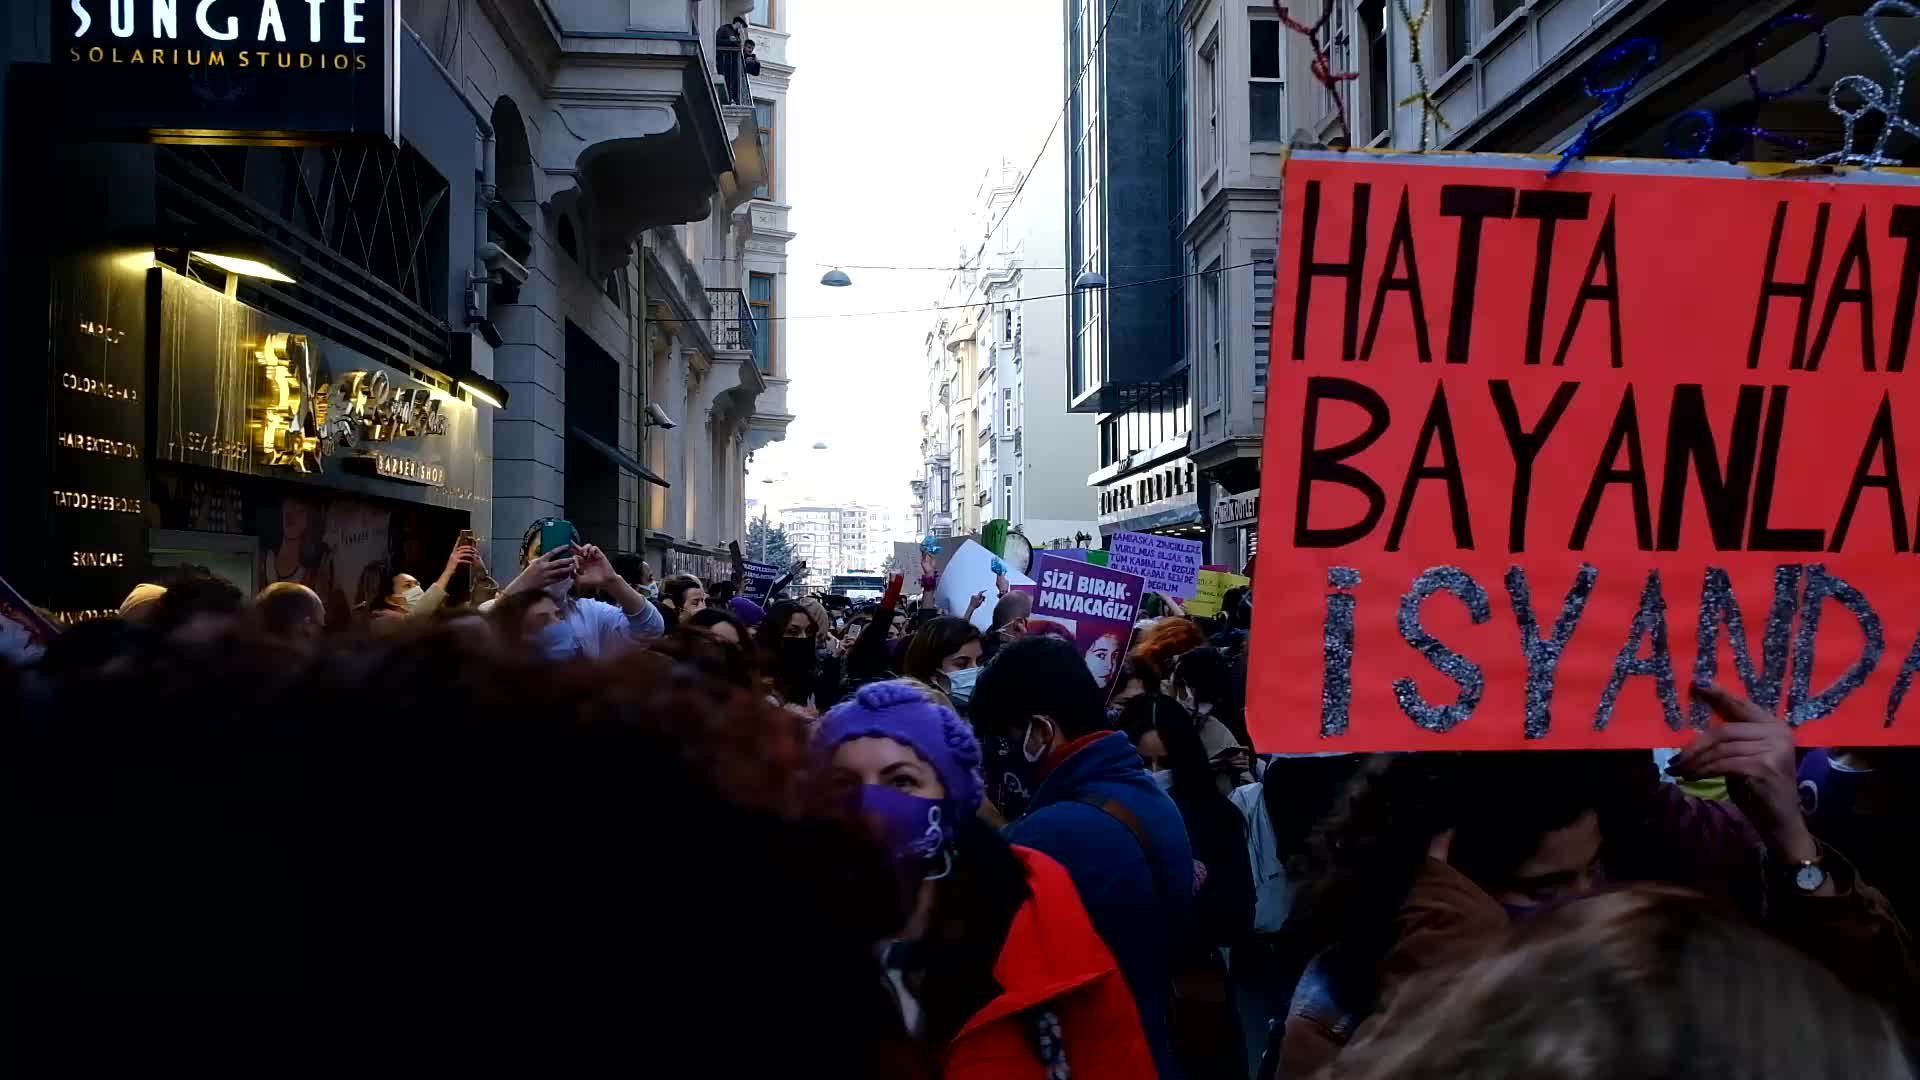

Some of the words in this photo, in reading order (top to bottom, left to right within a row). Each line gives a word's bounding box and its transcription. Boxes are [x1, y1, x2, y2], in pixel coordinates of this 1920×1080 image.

[70, 0, 366, 43] SUNGATE
[70, 46, 225, 67] SOLARIUM
[239, 50, 367, 71] STUDIOS
[1291, 180, 1624, 368] HATTA
[421, 465, 443, 482] SHOP
[1294, 375, 1920, 554] BAYANLA
[53, 490, 89, 508] TATOO
[72, 551, 97, 567] SKIN
[99, 552, 124, 567] CARE
[1041, 568, 1075, 591] SİZİ
[1076, 575, 1132, 600] BIRAK-
[1038, 590, 1134, 622] MAYACAĞIZ!
